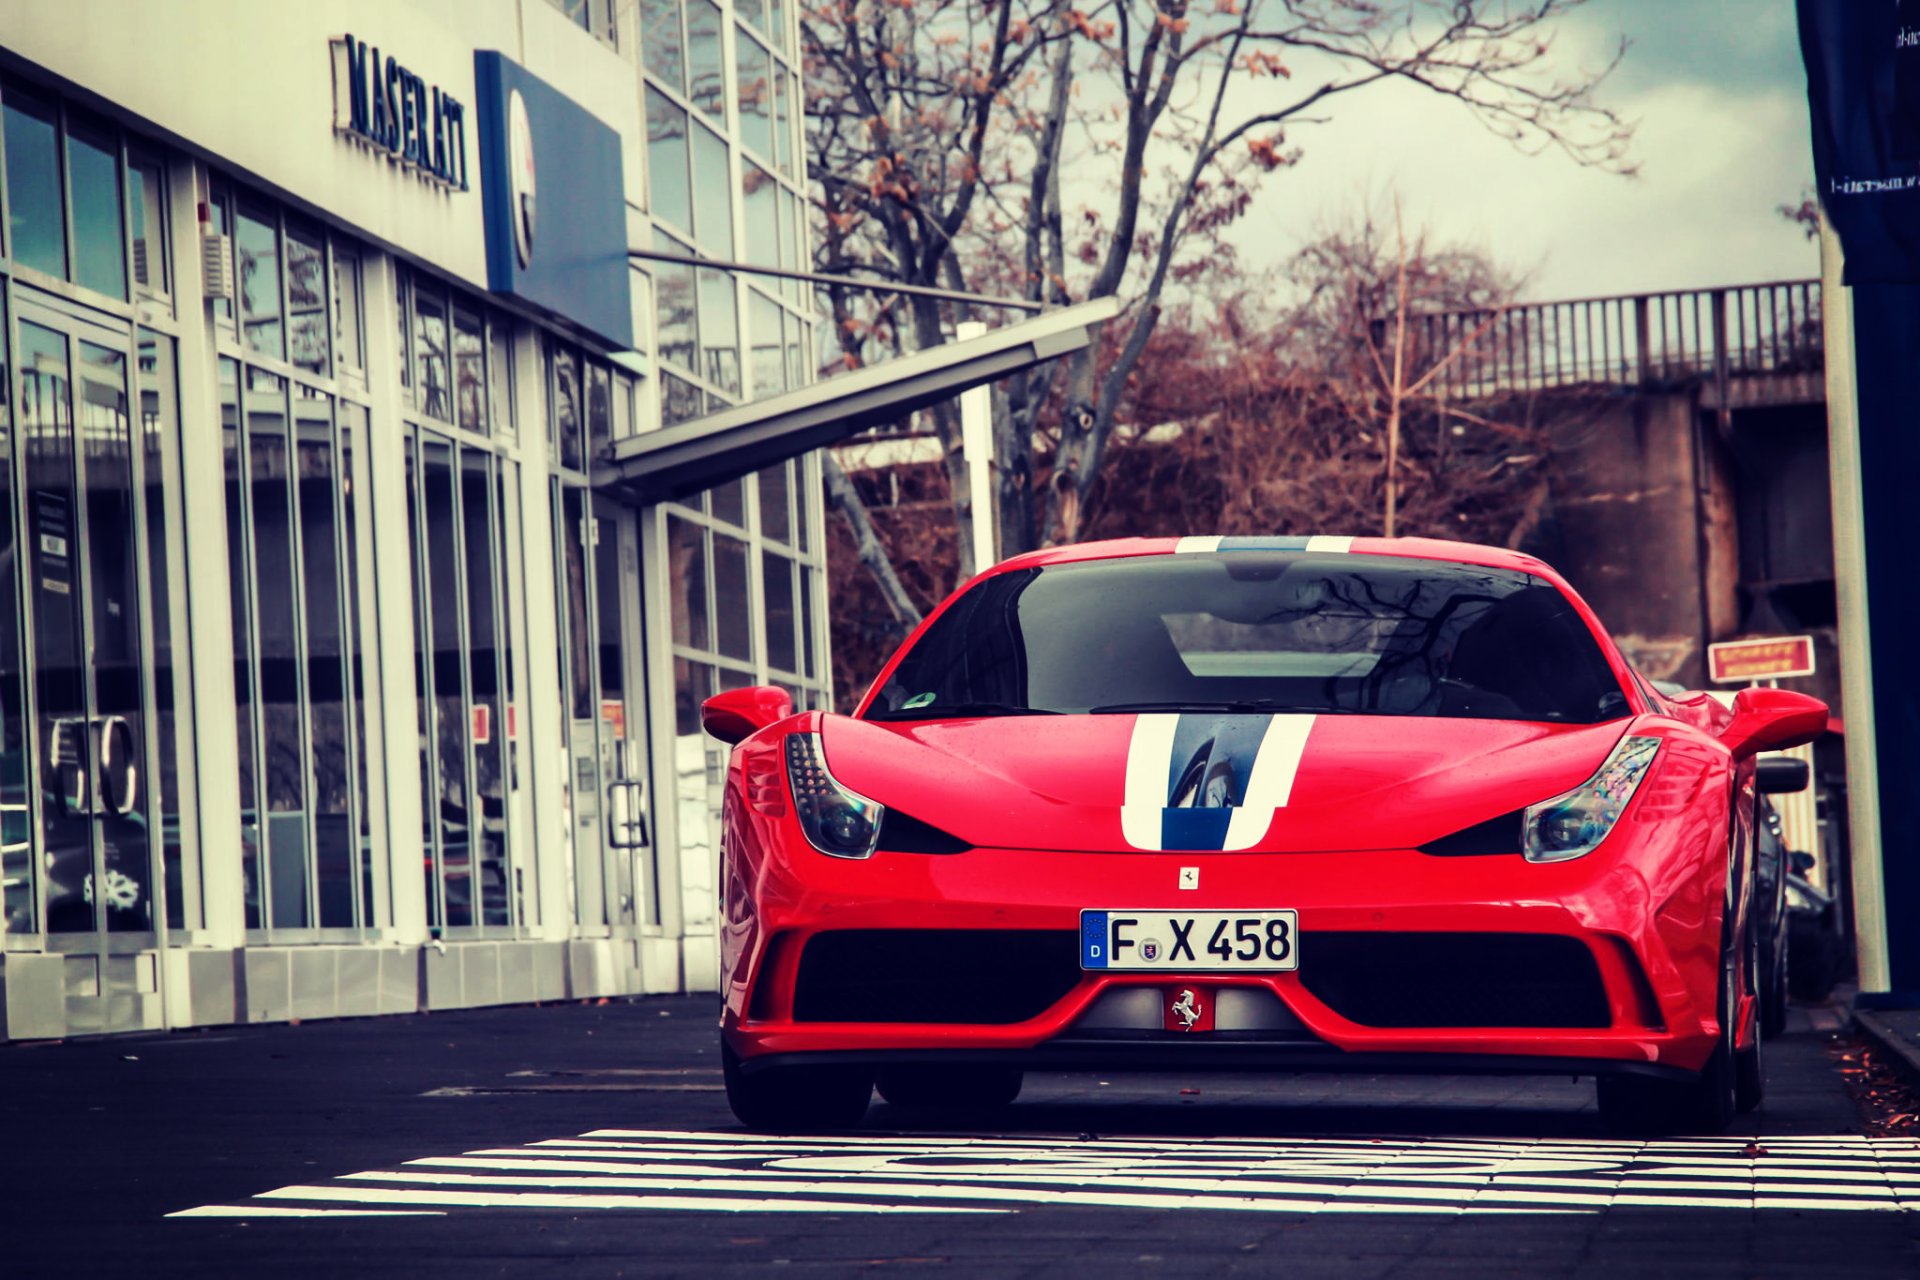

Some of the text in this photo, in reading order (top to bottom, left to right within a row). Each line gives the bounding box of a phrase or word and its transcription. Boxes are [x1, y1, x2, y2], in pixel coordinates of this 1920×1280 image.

[338, 32, 470, 193] MASERATI
[1090, 945, 1101, 958] D
[1111, 919, 1291, 962] F X 458
